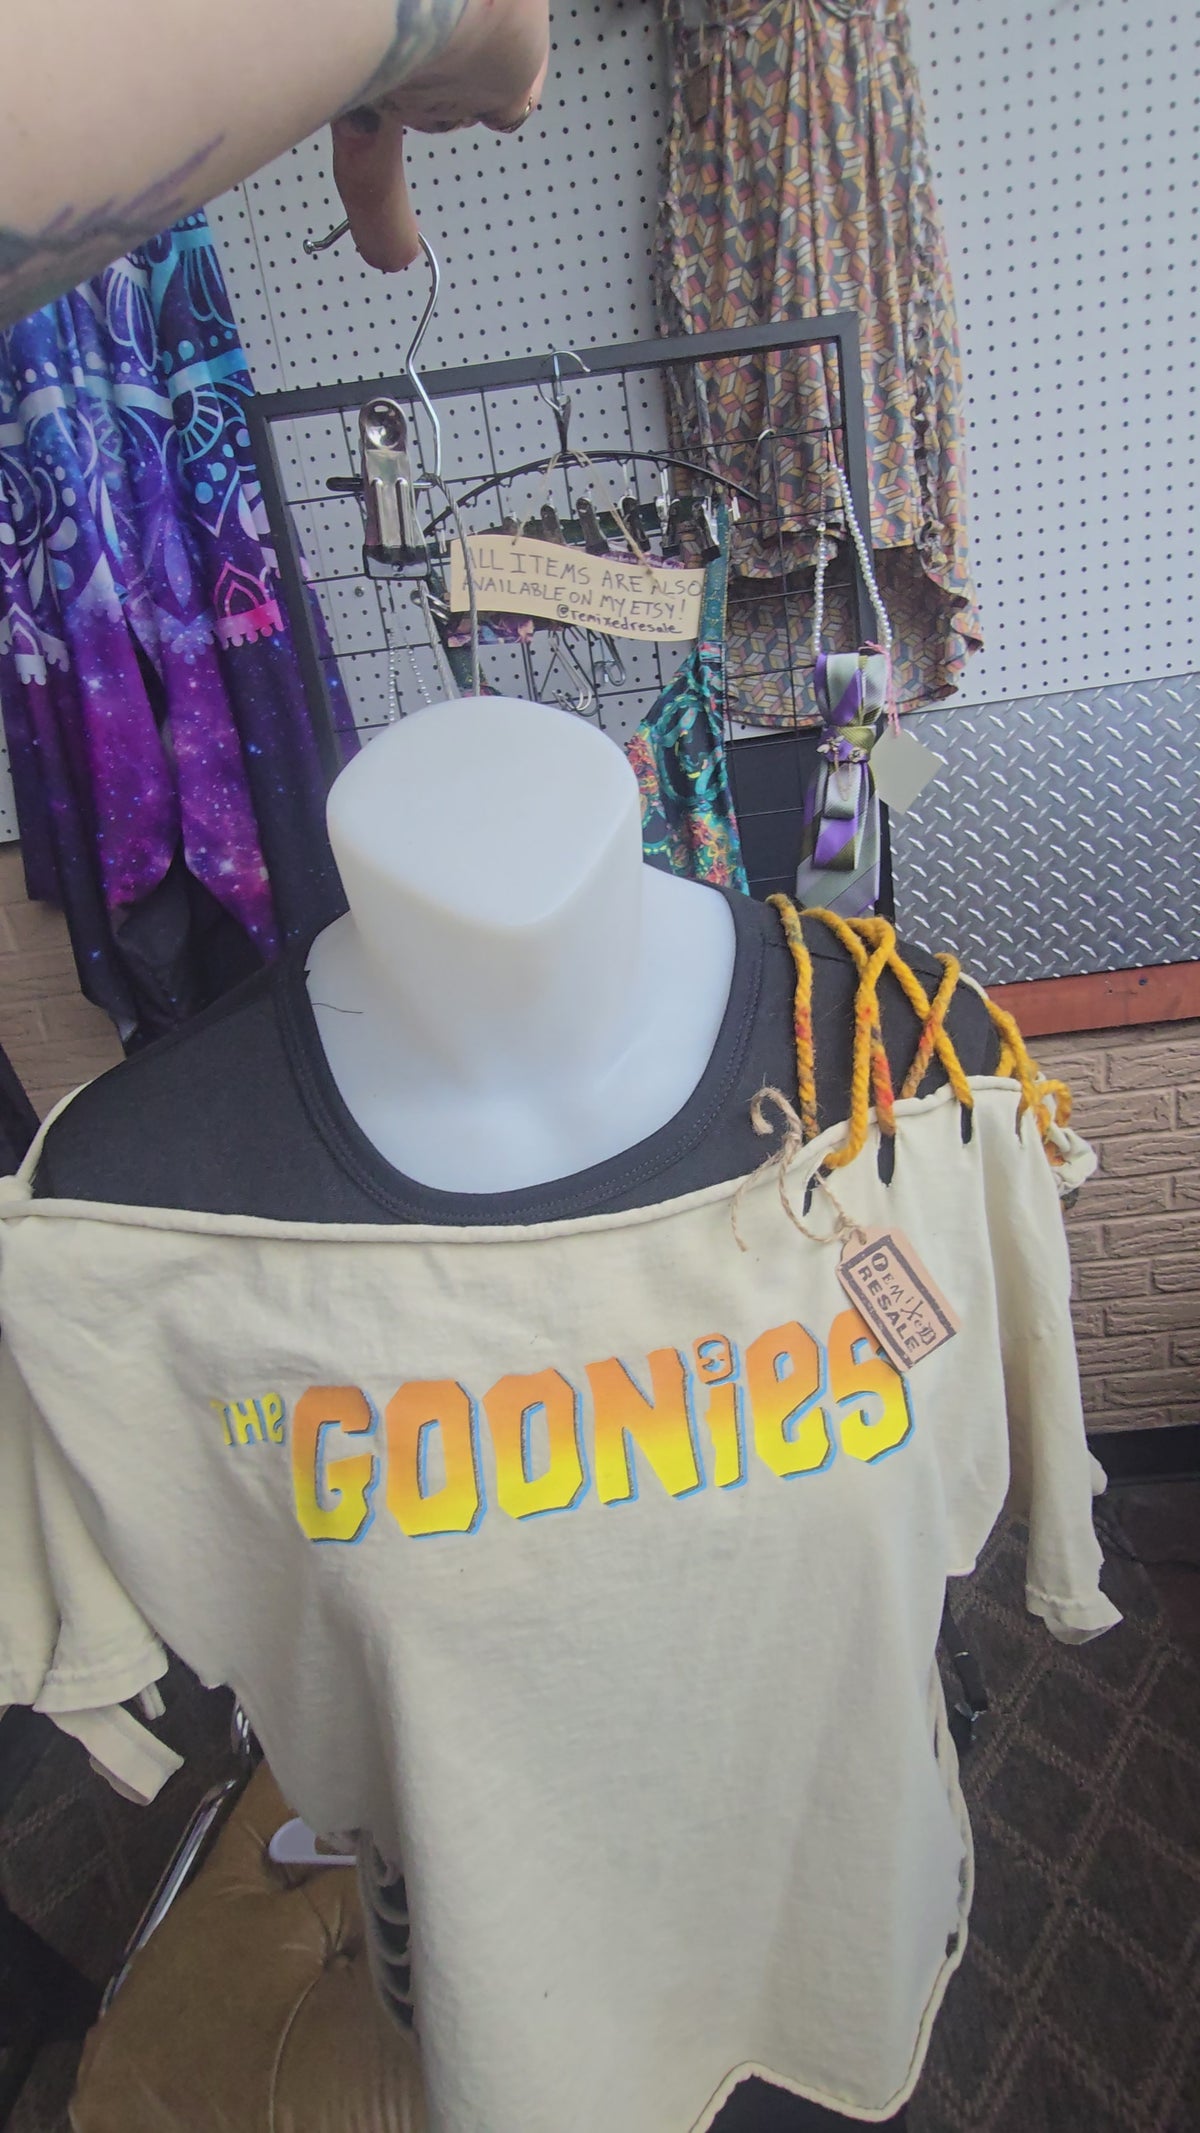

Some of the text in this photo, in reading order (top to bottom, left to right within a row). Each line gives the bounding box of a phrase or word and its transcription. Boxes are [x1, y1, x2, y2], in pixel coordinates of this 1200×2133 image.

[464, 547, 701, 597] ALL ITEMS ARE ALSO
[463, 577, 686, 620] AVAILABLE ON MY ETSY!
[857, 1265, 920, 1352] RESALE
